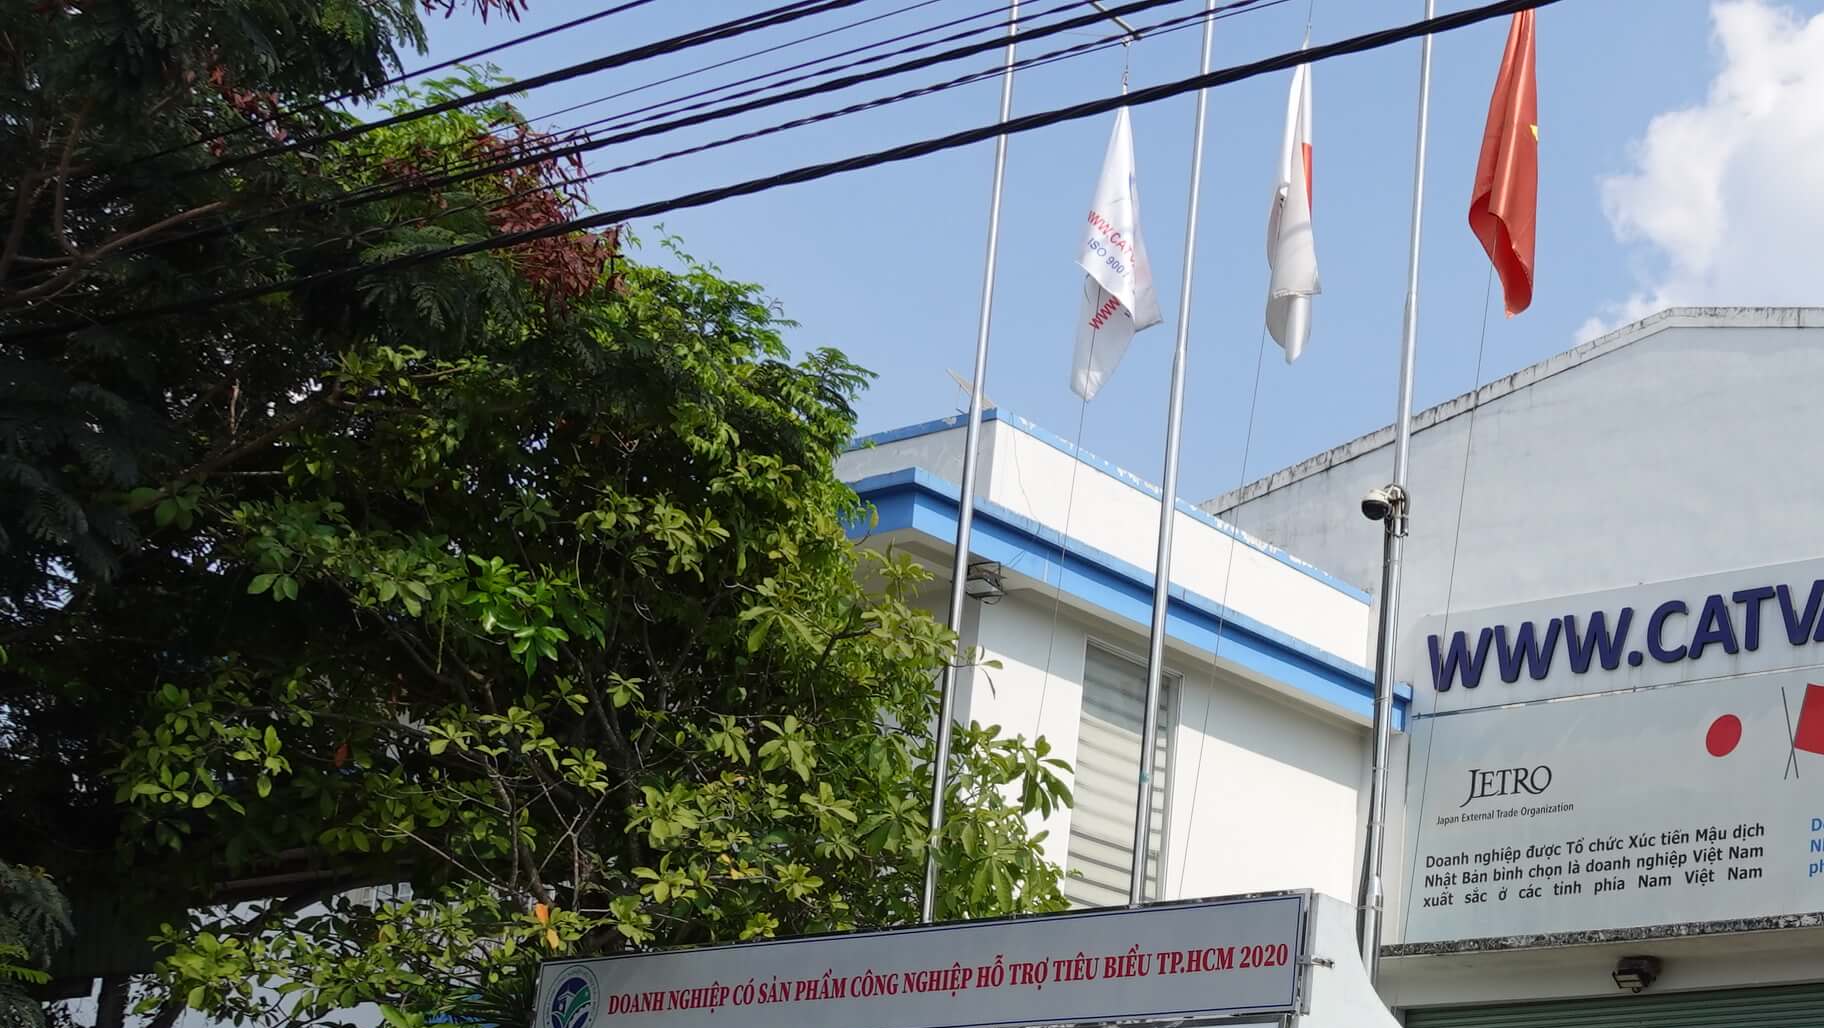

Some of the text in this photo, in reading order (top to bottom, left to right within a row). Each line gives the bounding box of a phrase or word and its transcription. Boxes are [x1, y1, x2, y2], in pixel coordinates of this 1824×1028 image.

[1460, 765, 1552, 807] JETRO
[1436, 801, 1574, 826] Japan External Trade Organization
[1425, 822, 1765, 868] Doanh nghiệp được Tổ chức Xúc tiến Mậu dịch
[607, 943, 1289, 1015] DOANH NGHIỆP CÓ SẢN PHẨM CÔNG NGHIỆP HỖ TRỢ TIÊU BIỂU TP.HCM 2020
